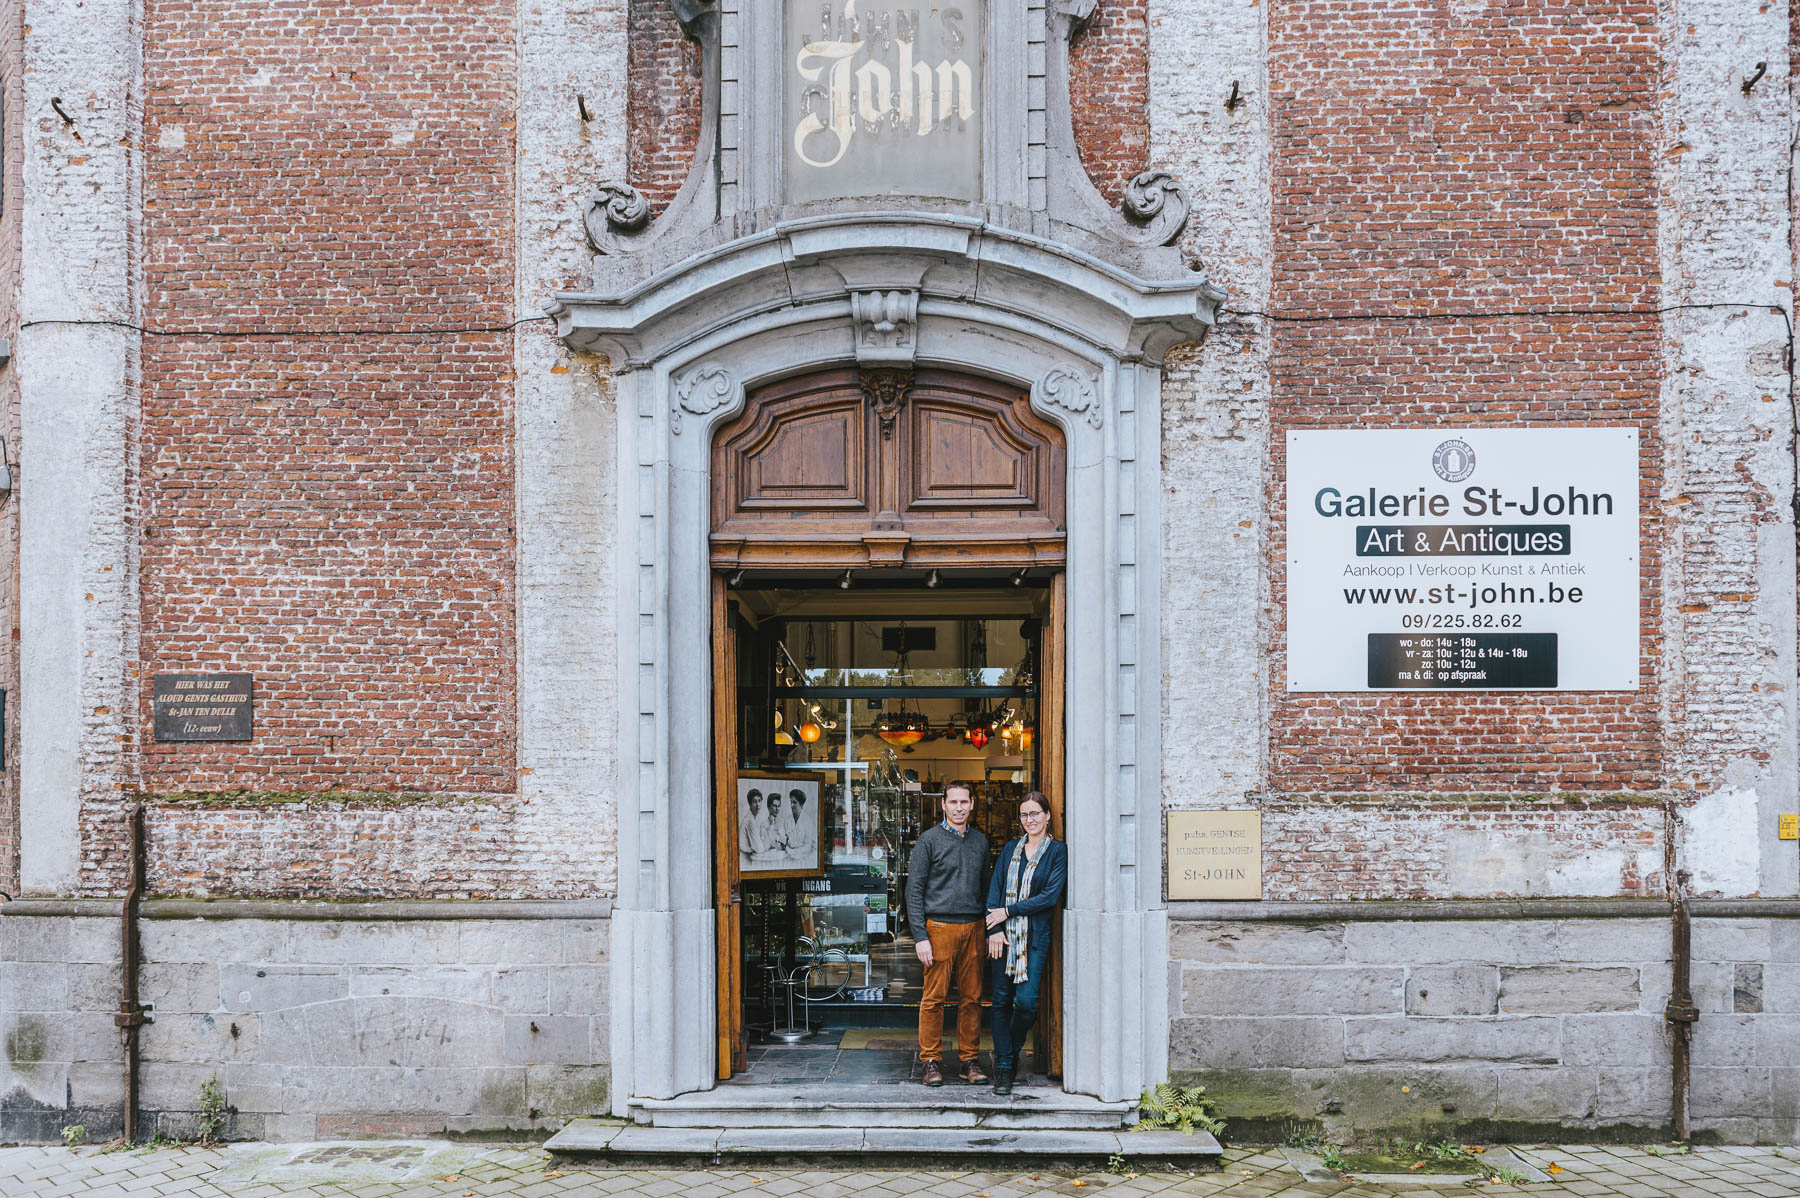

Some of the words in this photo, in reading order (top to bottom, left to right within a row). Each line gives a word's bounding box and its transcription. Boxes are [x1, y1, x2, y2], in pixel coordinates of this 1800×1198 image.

[794, 39, 976, 167] John
[1314, 487, 1450, 518] Galerie
[1463, 486, 1614, 516] St-John
[1363, 527, 1405, 553] Art
[1415, 532, 1431, 552] &
[1439, 527, 1564, 556] Antiques
[1343, 563, 1405, 578] Aankoop
[1416, 563, 1477, 578] Verkoop
[1482, 563, 1523, 576] Kunst
[1528, 566, 1536, 575] &
[1541, 562, 1586, 576] Antiek
[1343, 582, 1584, 609] www.st-john.be
[1402, 614, 1522, 629] 09/225.82.62
[1399, 639, 1413, 647] wo
[1420, 638, 1434, 647] do:
[1436, 638, 1452, 647] 14u
[1460, 638, 1476, 647] 18u
[1405, 650, 1415, 658] vr
[1421, 650, 1434, 658] za:
[1436, 649, 1452, 658] 10u
[1460, 649, 1476, 658] 12u
[1478, 649, 1486, 658] &
[1487, 649, 1504, 658] 14u
[1511, 649, 1528, 658] 18u
[1421, 660, 1434, 669] zo:
[1436, 660, 1452, 669] 10u
[1460, 660, 1476, 669] 12u
[1398, 671, 1412, 680] ma
[1413, 671, 1421, 680] &
[1423, 670, 1434, 680] di:
[1438, 672, 1449, 682] op
[1451, 670, 1487, 682] afspraak
[175, 681, 195, 689] HIER
[196, 681, 212, 689] WAS
[213, 681, 231, 689] HET
[158, 694, 184, 703] ALOUD
[185, 694, 210, 703] GENTS
[210, 694, 248, 703] GASTHUIS
[195, 707, 210, 716] TEN
[210, 707, 237, 716] DULLE
[1209, 830, 1246, 839] GENTSE
[1175, 847, 1254, 856] KUNSTVEILINGEN
